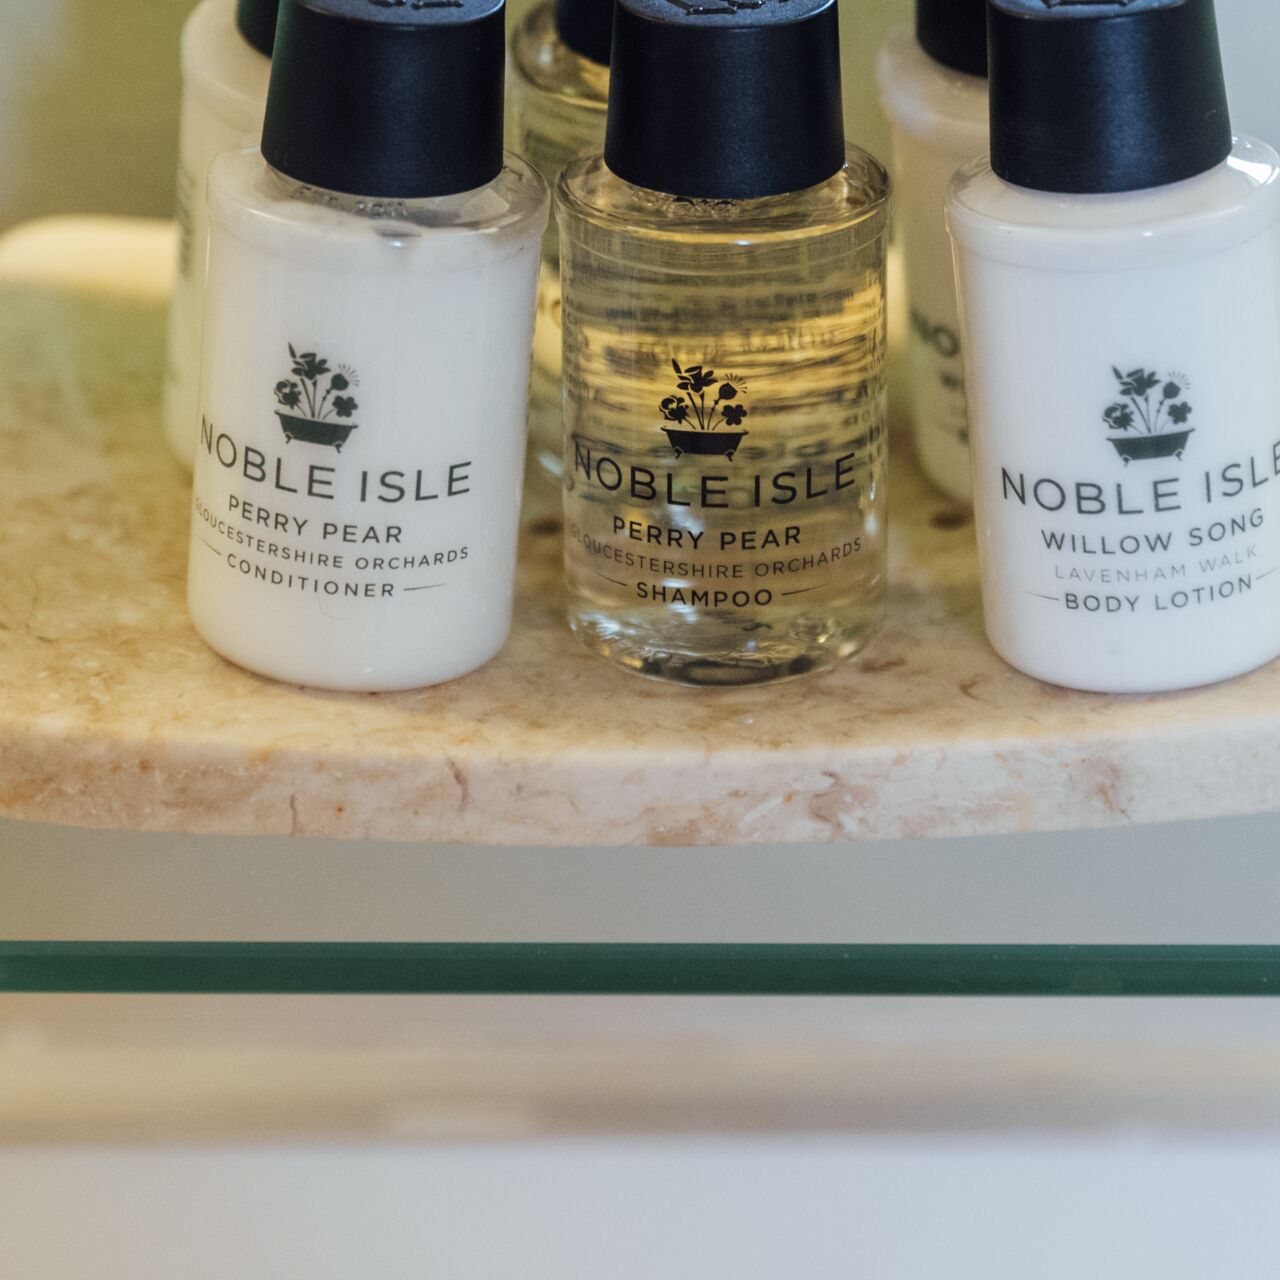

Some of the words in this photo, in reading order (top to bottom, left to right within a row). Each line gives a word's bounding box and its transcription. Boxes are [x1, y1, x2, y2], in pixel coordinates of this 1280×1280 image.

[200, 414, 336, 500] NOBLE
[360, 461, 472, 503] ISLE
[574, 439, 729, 508] NOBLE
[754, 453, 856, 508] ISLE
[1001, 467, 1182, 515] NOBLE
[228, 494, 308, 536] PERRY
[323, 523, 402, 544] PEAR
[614, 515, 704, 550] PERRY
[721, 525, 801, 551] PEAR
[1041, 530, 1172, 555] WILLOW
[1189, 508, 1265, 548] SONG
[355, 546, 469, 570] ORCHARDS
[571, 523, 744, 578] LOUCESTERSHIRE
[755, 537, 862, 578] ORCHARDS
[1054, 564, 1186, 583] LAVENHAM
[1199, 544, 1258, 573] WALK
[227, 553, 394, 597] CONDITIONER
[636, 582, 773, 608] SHAMPOO
[1066, 593, 1140, 612] BODY
[1155, 574, 1252, 611] LOTION
